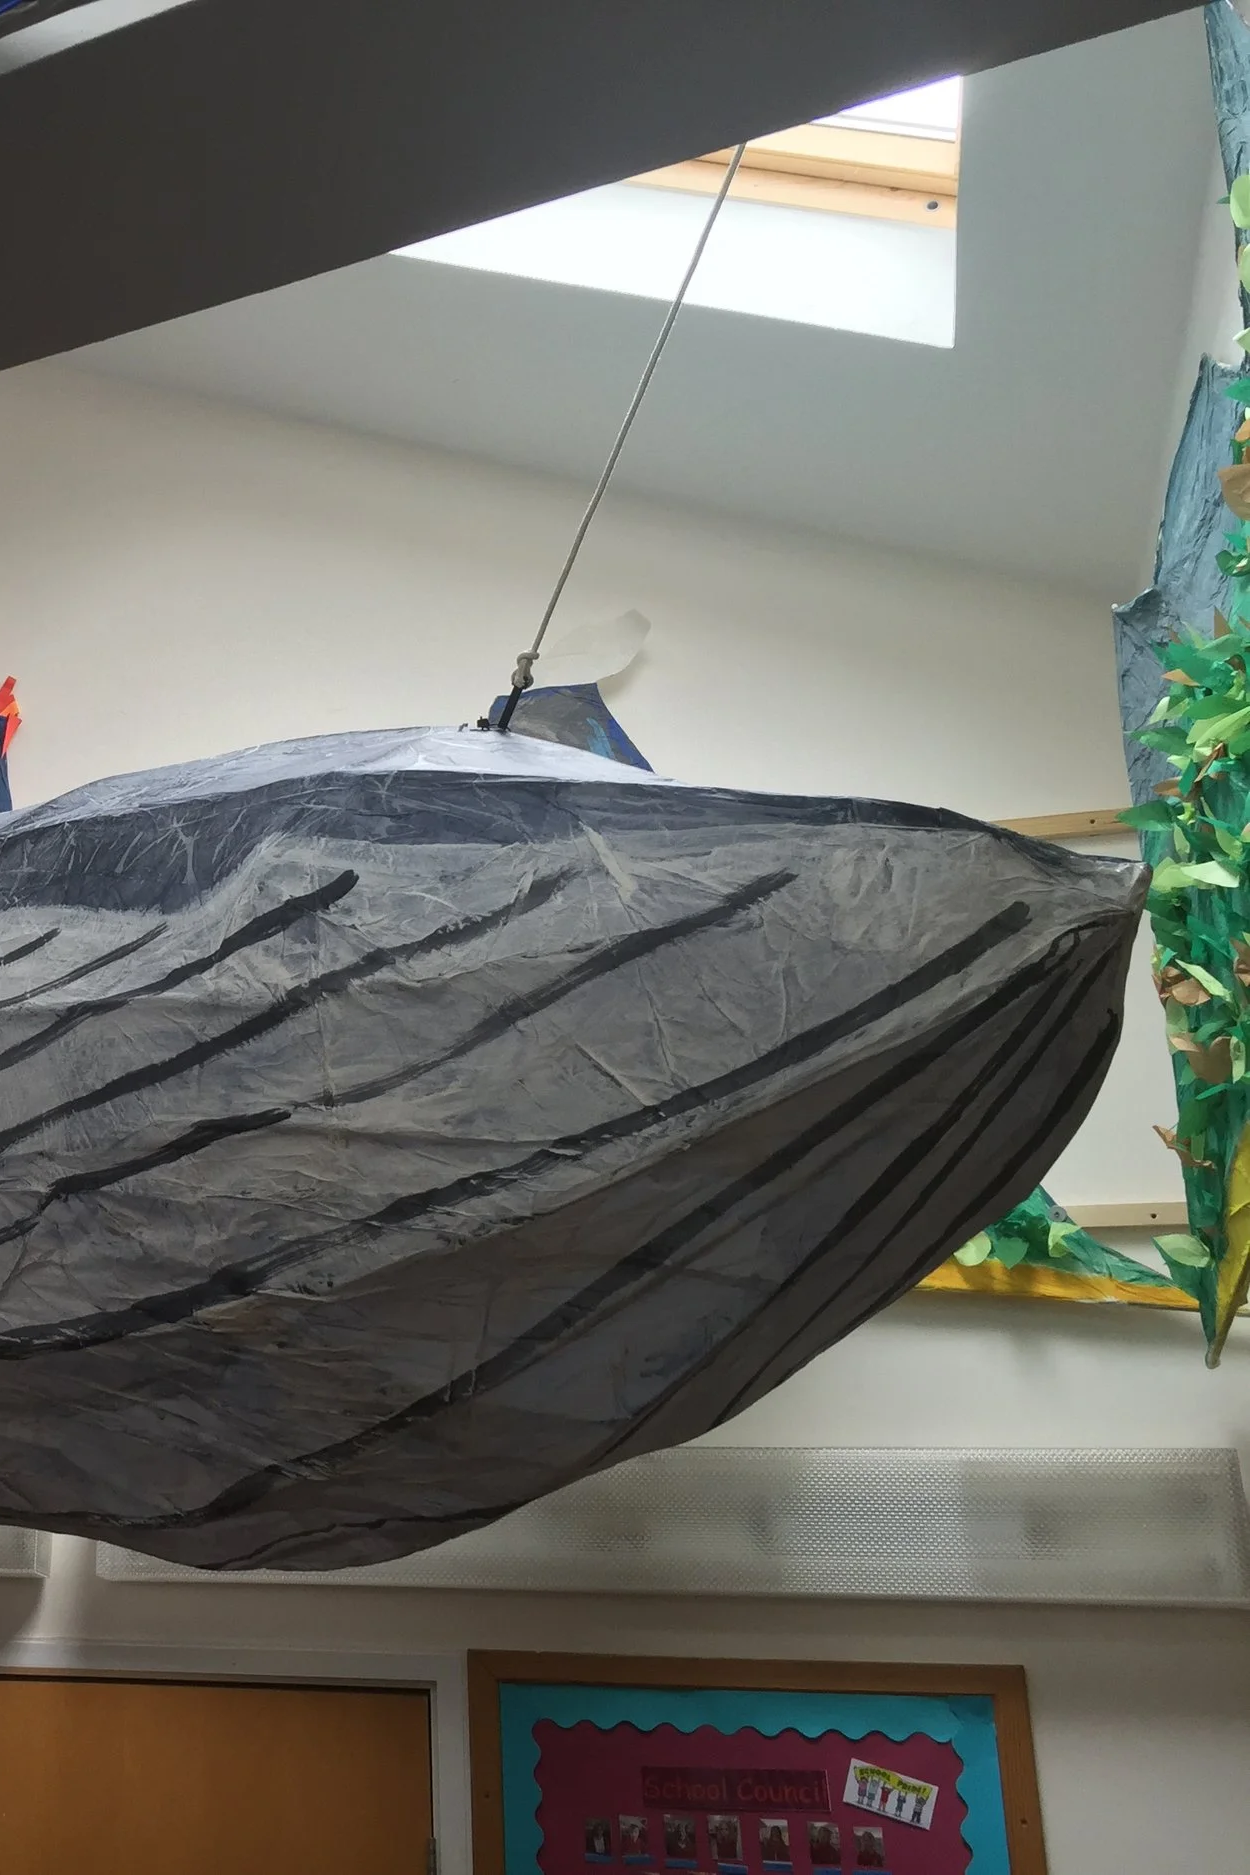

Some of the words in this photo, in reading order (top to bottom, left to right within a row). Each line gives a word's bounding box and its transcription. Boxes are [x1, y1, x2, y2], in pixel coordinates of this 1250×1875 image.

[858, 1768, 891, 1782] SCHOOL
[644, 1773, 727, 1801] School
[736, 1777, 827, 1804] Council
